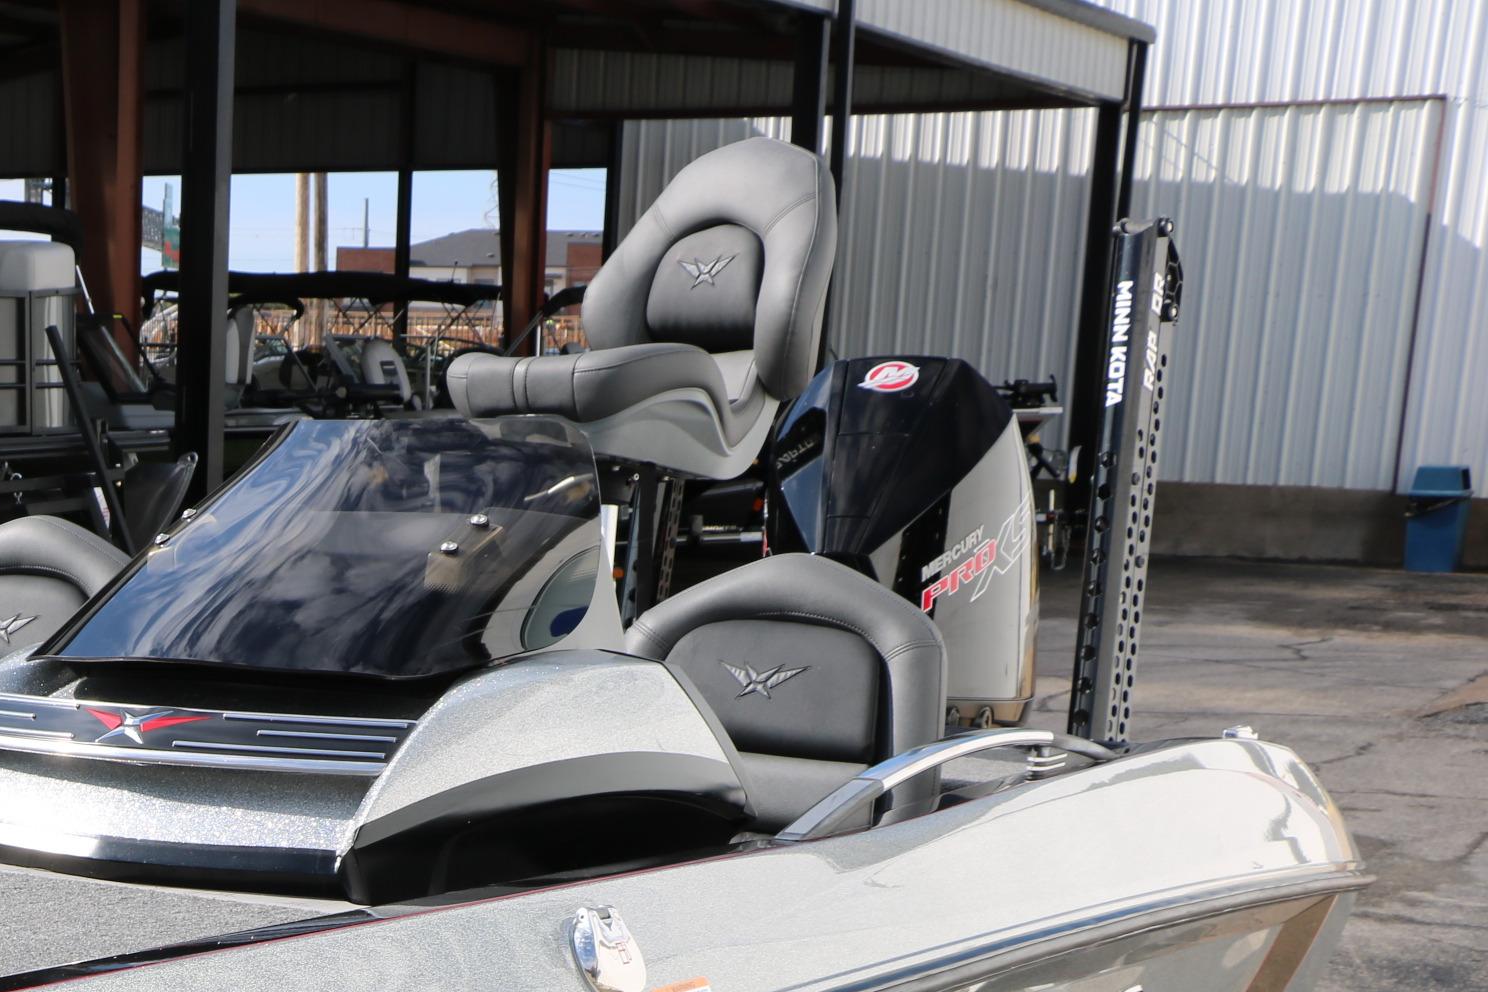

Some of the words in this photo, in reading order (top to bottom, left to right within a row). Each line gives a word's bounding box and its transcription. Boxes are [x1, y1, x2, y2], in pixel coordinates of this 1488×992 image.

[1112, 280, 1134, 342] MINN
[1105, 346, 1127, 408] KOTA
[921, 524, 985, 583] MERCURY
[921, 538, 997, 613] PRO
